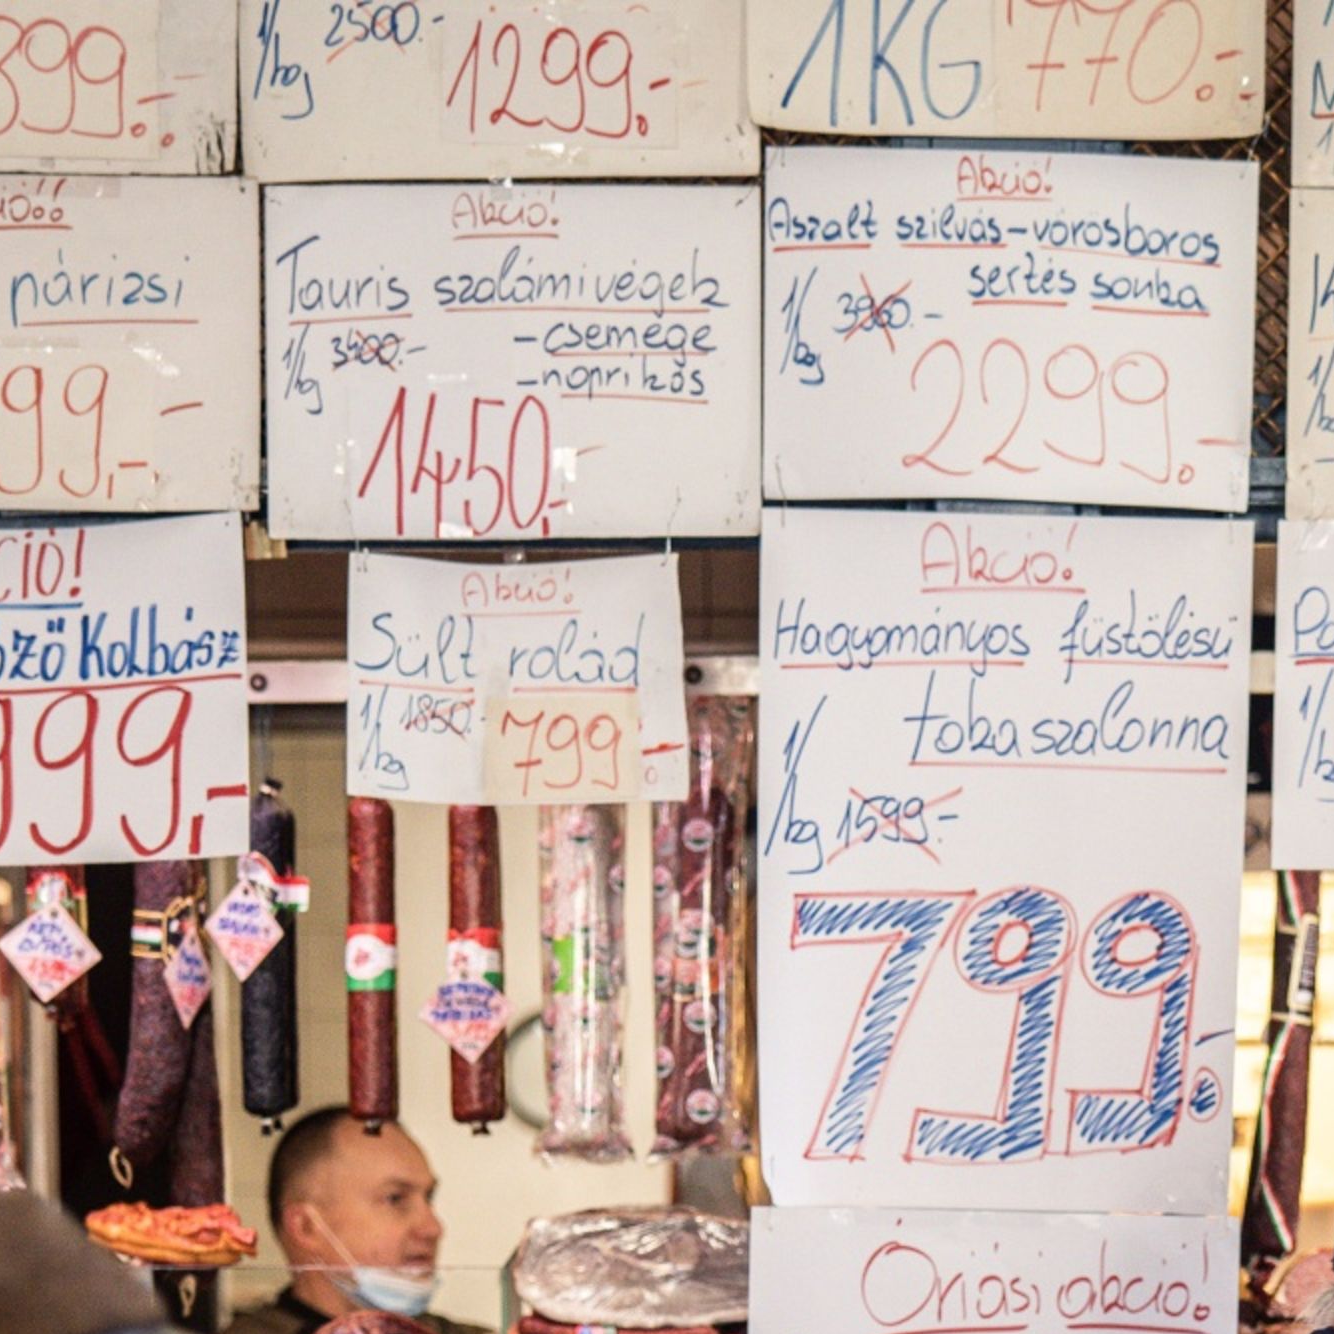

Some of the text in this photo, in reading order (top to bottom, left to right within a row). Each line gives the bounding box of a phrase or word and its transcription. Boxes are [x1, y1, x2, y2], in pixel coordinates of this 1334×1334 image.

[446, 20, 672, 139] 1299.-
[275, 235, 412, 315] Tauris
[902, 338, 1242, 486] 2299.-
[353, 611, 647, 688] Sült rolád
[774, 598, 1031, 678] Hagyományos
